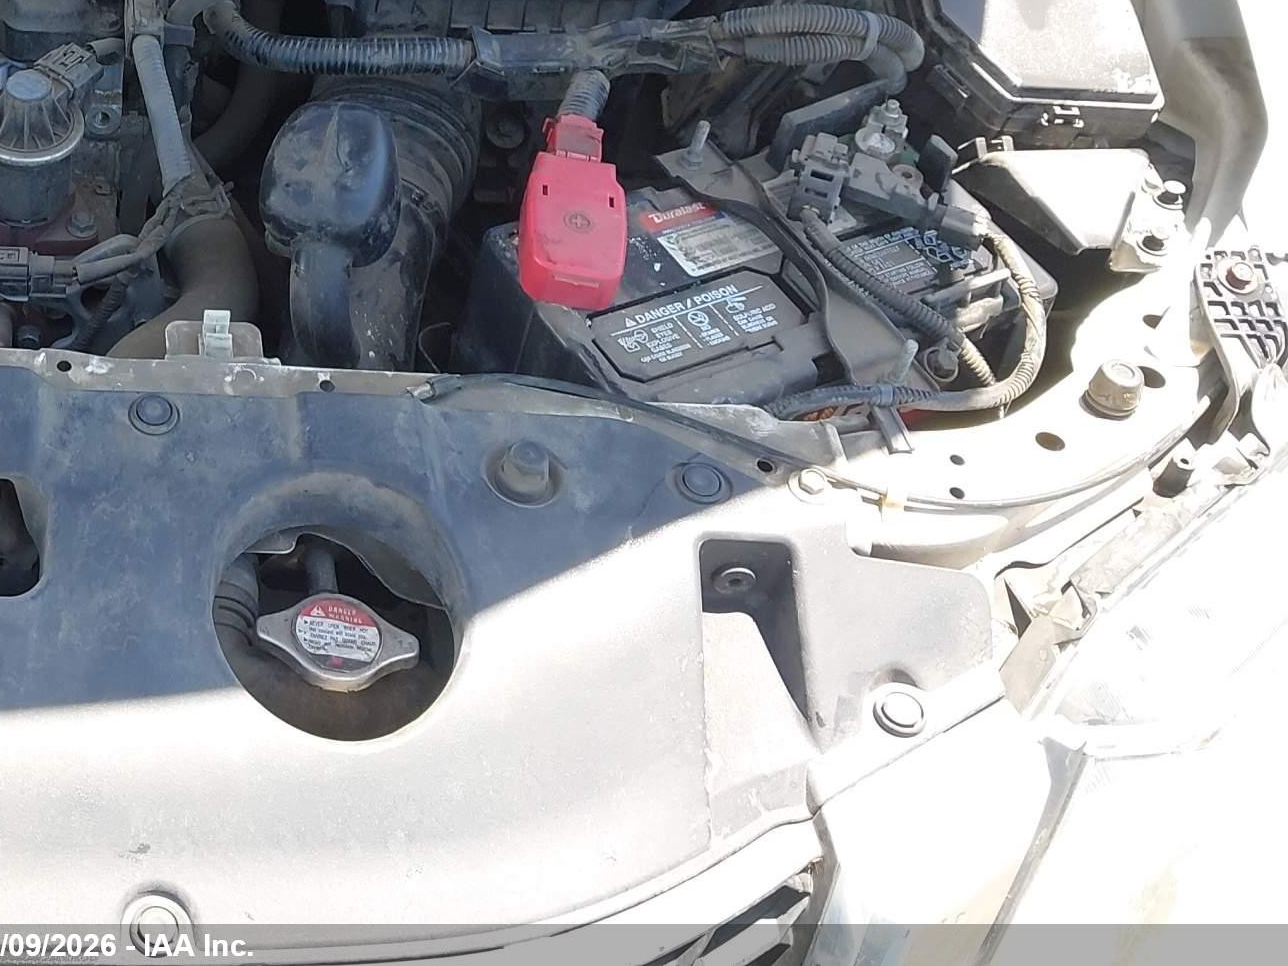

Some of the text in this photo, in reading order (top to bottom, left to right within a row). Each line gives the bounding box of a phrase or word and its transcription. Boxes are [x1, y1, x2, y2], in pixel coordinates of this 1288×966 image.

[648, 202, 706, 224] Duralast
[635, 302, 686, 324] DANGER
[693, 284, 738, 305] POISON
